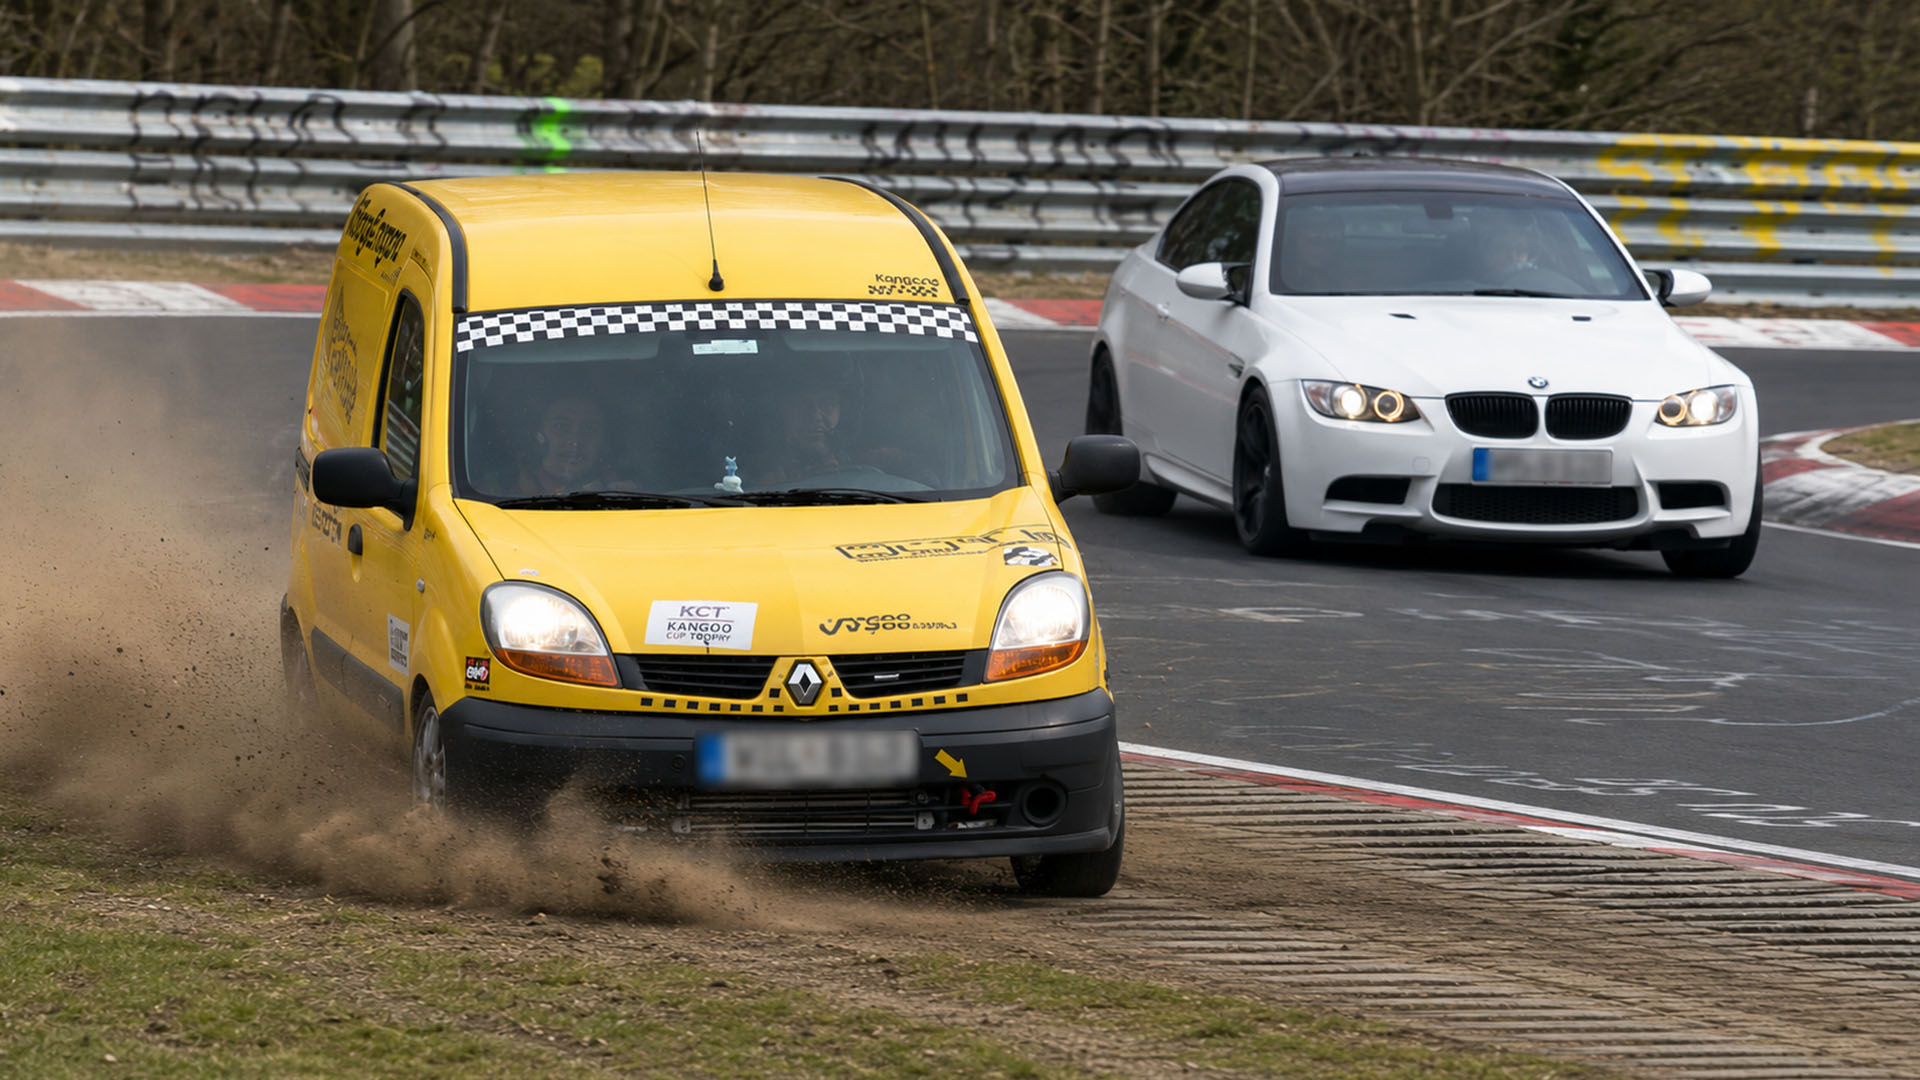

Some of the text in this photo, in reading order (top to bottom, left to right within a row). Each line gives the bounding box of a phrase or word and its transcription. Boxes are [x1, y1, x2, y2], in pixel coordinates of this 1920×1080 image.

[680, 605, 726, 618] KCT
[667, 621, 732, 634] KANGOO
[666, 632, 686, 640] CUP
